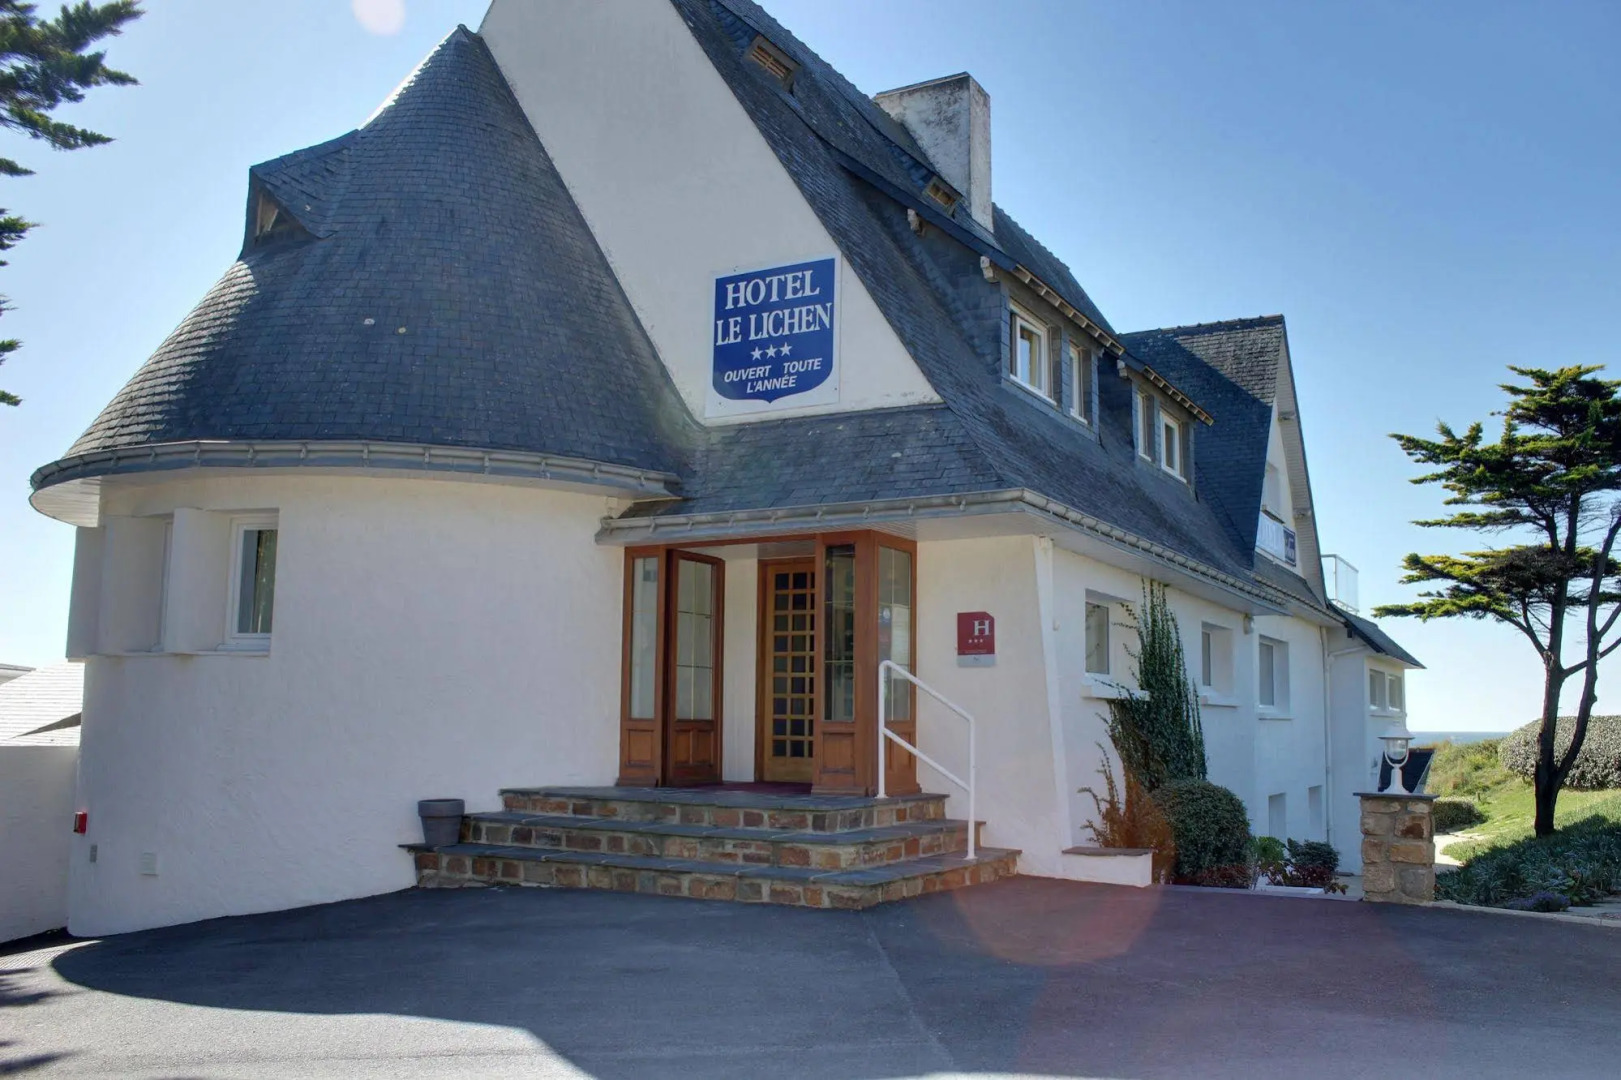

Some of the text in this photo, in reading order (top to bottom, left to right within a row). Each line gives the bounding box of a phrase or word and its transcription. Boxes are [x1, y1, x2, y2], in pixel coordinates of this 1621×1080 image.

[725, 270, 820, 310] HOTEL
[716, 302, 832, 346] LE LICHEN
[724, 358, 822, 383] OUVERT TOUTE
[746, 375, 797, 394] L'ANNÉE
[974, 620, 990, 636] H
